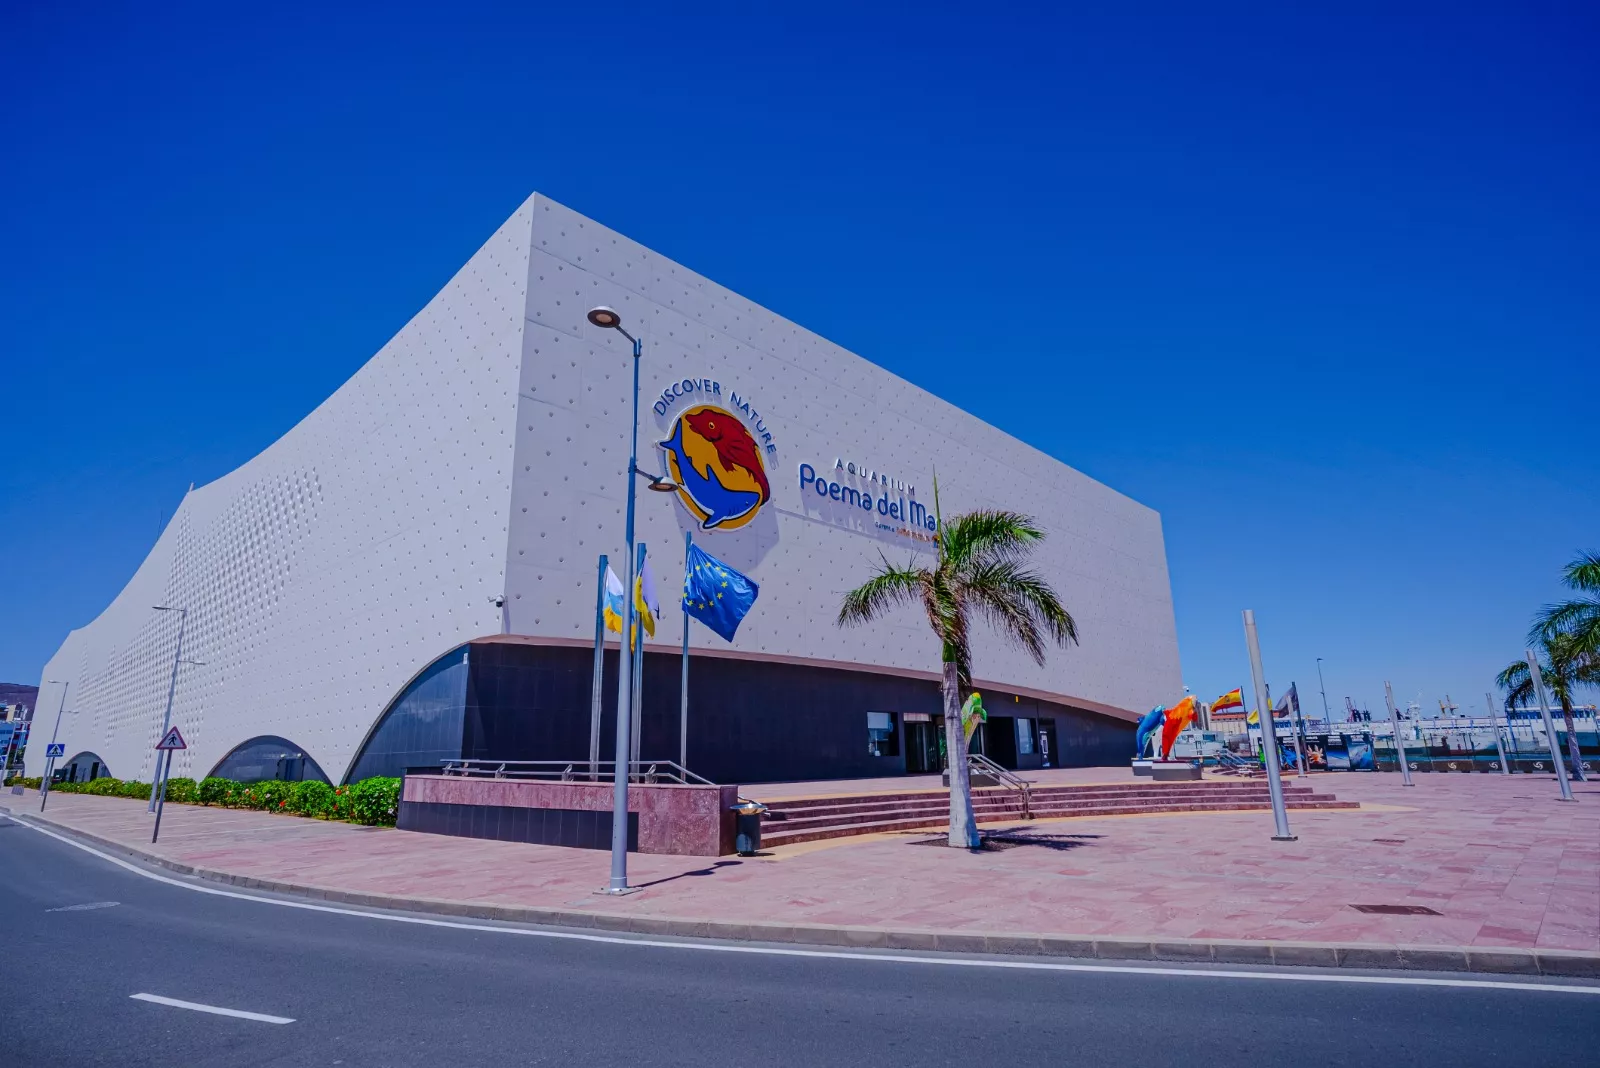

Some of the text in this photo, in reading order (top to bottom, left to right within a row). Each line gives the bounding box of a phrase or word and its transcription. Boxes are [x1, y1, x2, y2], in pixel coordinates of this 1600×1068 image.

[653, 378, 777, 454] DISCOVER NATURE
[799, 463, 939, 532] Poema del Ma
[835, 458, 915, 496] AQUARIUM
